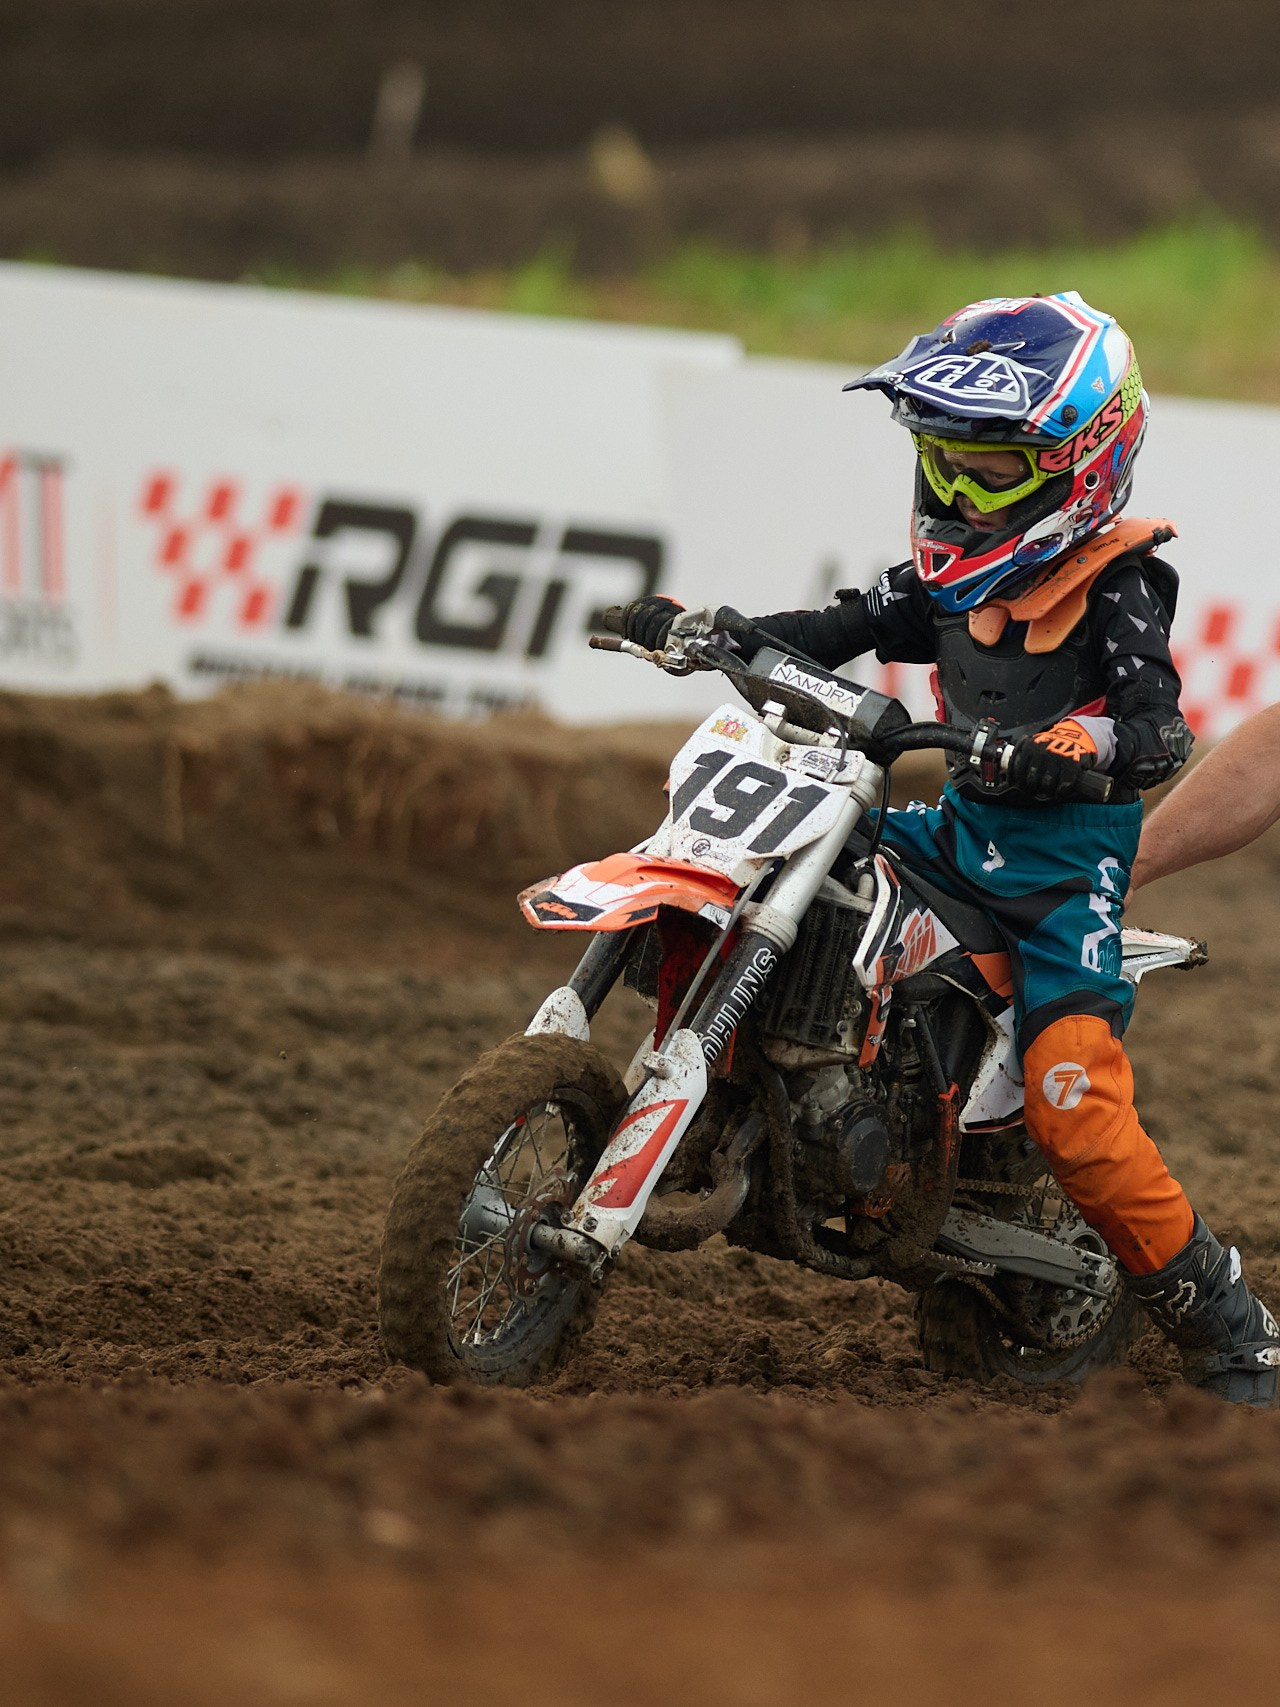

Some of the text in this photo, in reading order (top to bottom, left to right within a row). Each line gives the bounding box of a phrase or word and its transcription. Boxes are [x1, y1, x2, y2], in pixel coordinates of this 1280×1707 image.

[1038, 391, 1122, 473] EKS
[286, 498, 664, 660] RGP
[774, 666, 855, 708] NAMURA
[672, 749, 831, 854] 191
[1053, 1069, 1084, 1106] 7
